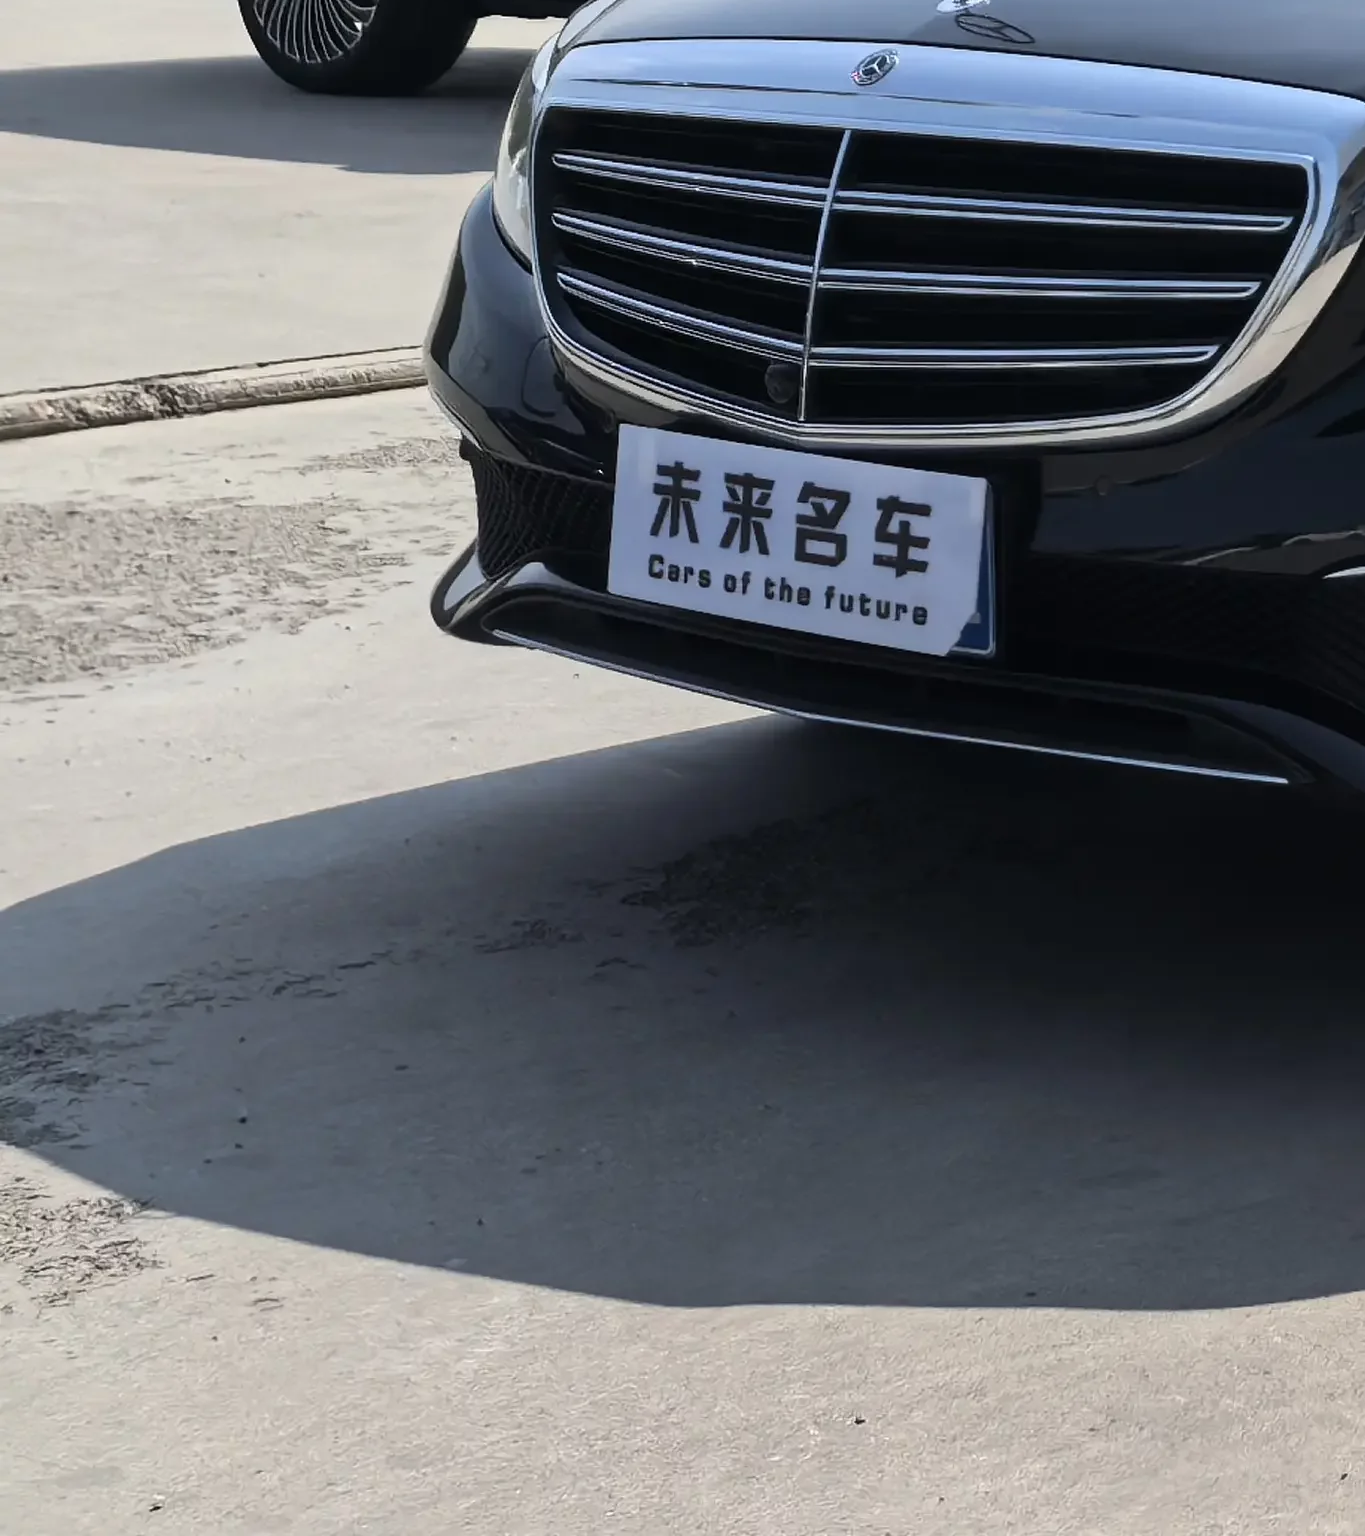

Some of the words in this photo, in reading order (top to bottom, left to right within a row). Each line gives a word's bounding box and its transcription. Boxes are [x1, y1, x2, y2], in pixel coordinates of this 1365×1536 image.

[650, 460, 932, 578] 未来名车
[647, 553, 712, 589] Cars
[723, 570, 751, 596] of
[764, 576, 811, 607] the
[824, 584, 929, 626] future
